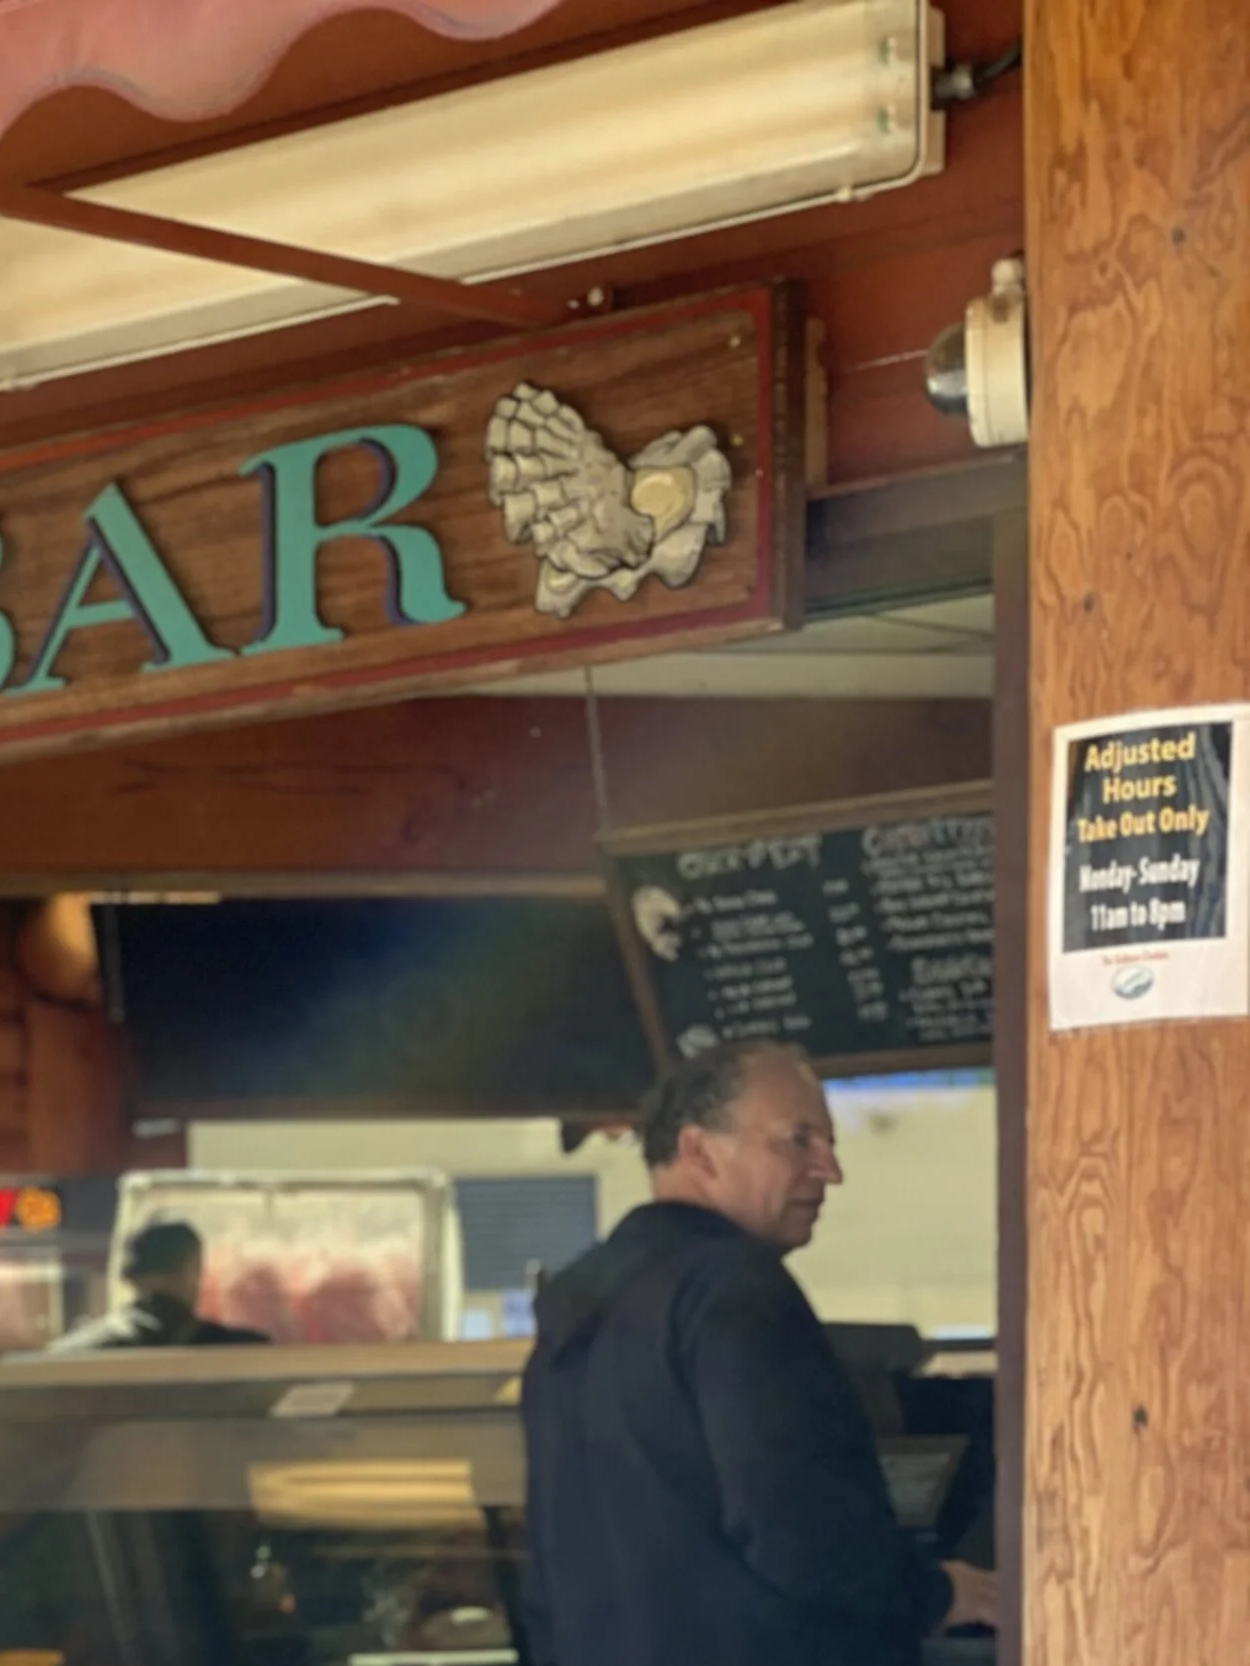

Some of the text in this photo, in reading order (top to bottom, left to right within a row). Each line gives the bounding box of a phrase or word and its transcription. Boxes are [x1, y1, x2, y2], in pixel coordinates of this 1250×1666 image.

[1084, 731, 1196, 773] Adjusted
[1102, 775, 1177, 804] Hours
[1077, 803, 1209, 843] Take Out Only
[1130, 901, 1147, 926] to
